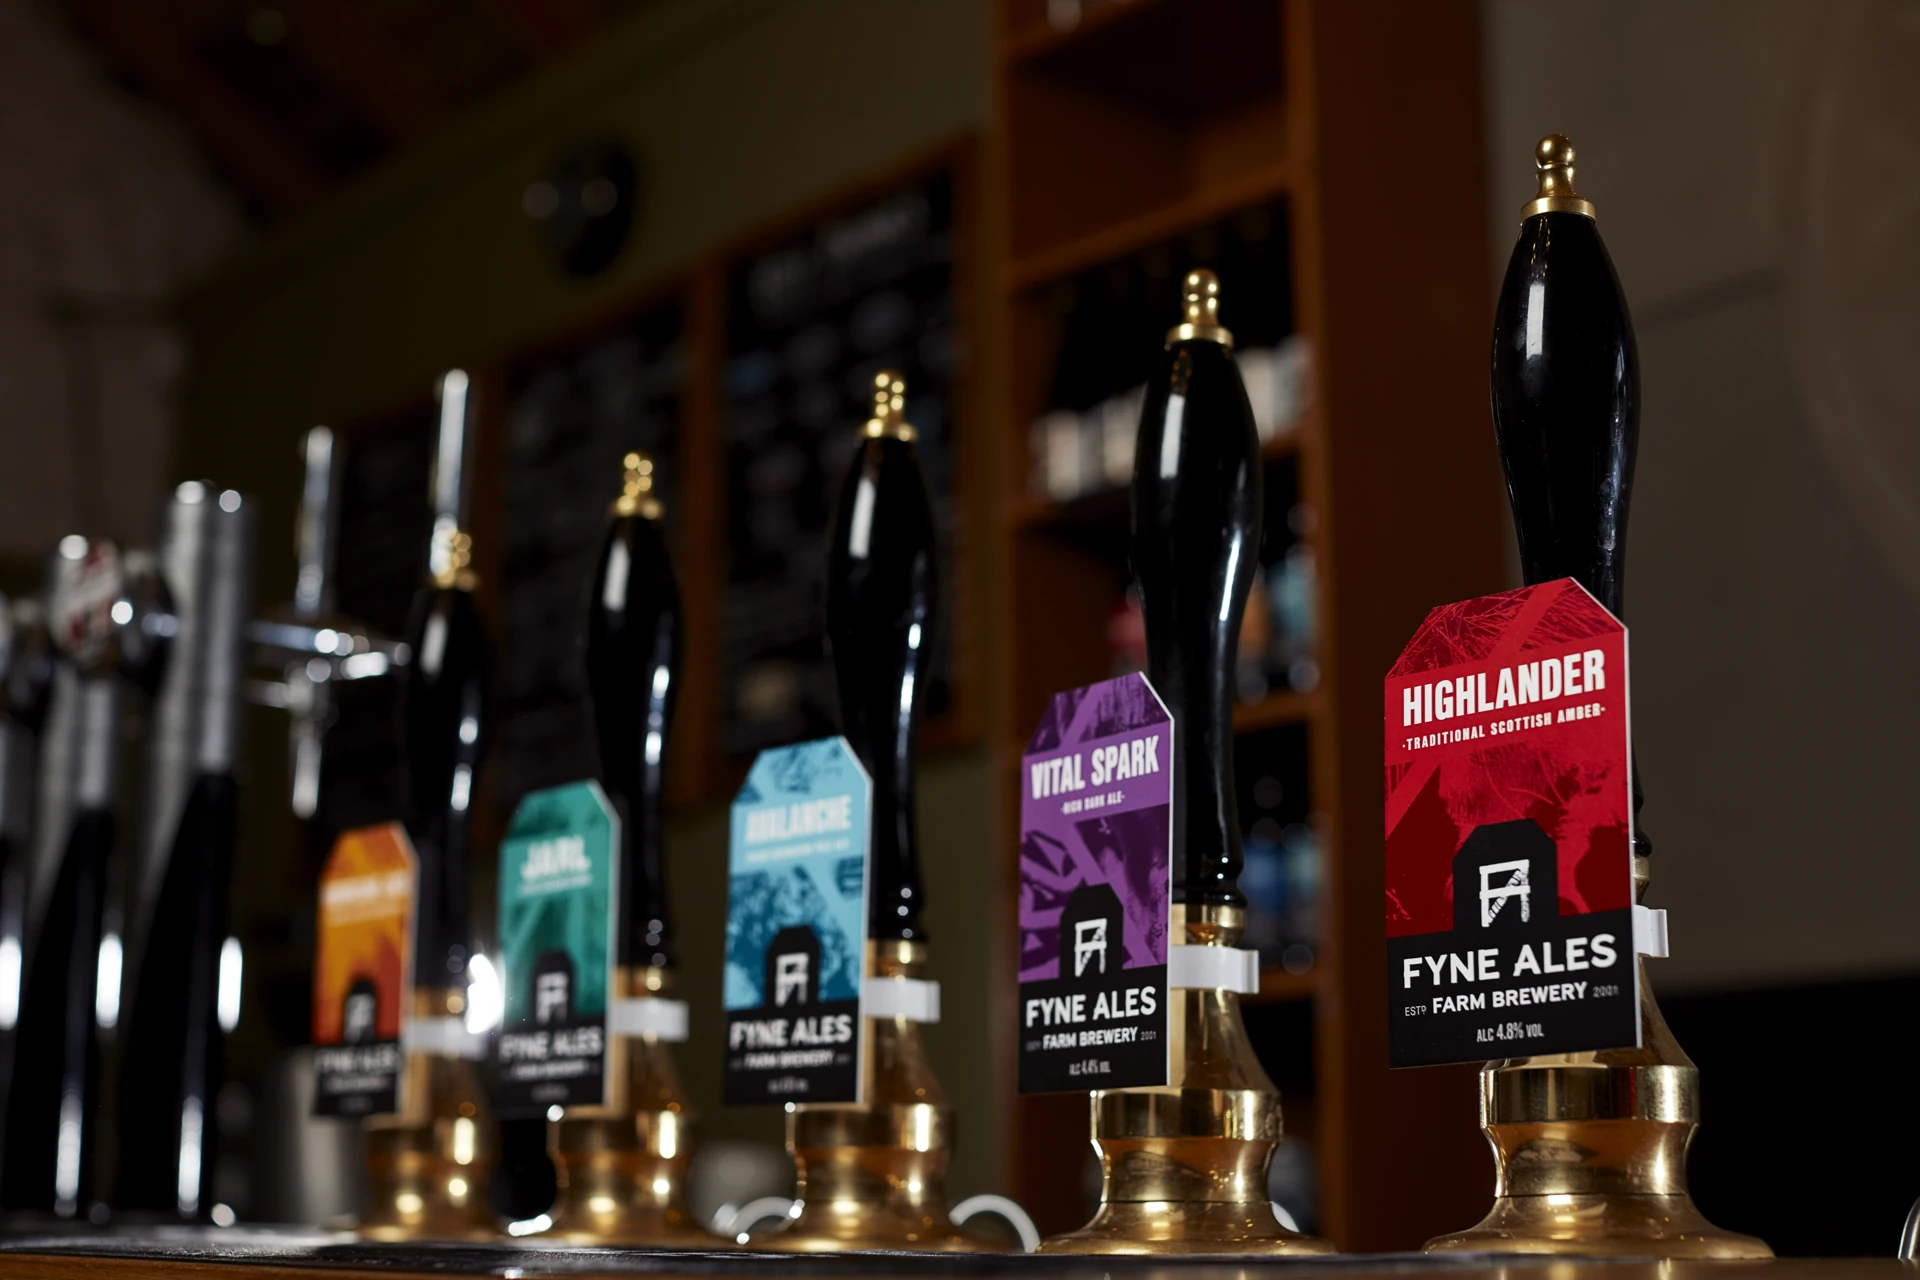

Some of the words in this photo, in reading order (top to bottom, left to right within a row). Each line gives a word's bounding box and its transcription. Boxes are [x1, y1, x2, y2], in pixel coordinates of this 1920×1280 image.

[1403, 649, 1605, 727] HIGHLANDER
[1490, 711, 1552, 736] SCOTTISH
[1031, 753, 1086, 800] VITAL
[1091, 735, 1160, 787] SPARK
[1403, 947, 1500, 989] FYNE
[1512, 933, 1618, 978] ALES
[1026, 994, 1086, 1028] FYNE
[1092, 985, 1157, 1020] ALES
[1432, 992, 1486, 1015] FARM
[1492, 981, 1588, 1008] BREWERY
[1593, 984, 1619, 998] 2001
[729, 1018, 789, 1051] FYNE
[790, 1014, 852, 1046] ALES
[1042, 1032, 1077, 1051] FARM
[1079, 1026, 1138, 1047] BREWERY
[1476, 1028, 1494, 1042] ALC
[1496, 1022, 1524, 1041] 4.8%
[1526, 1023, 1544, 1039] VOL
